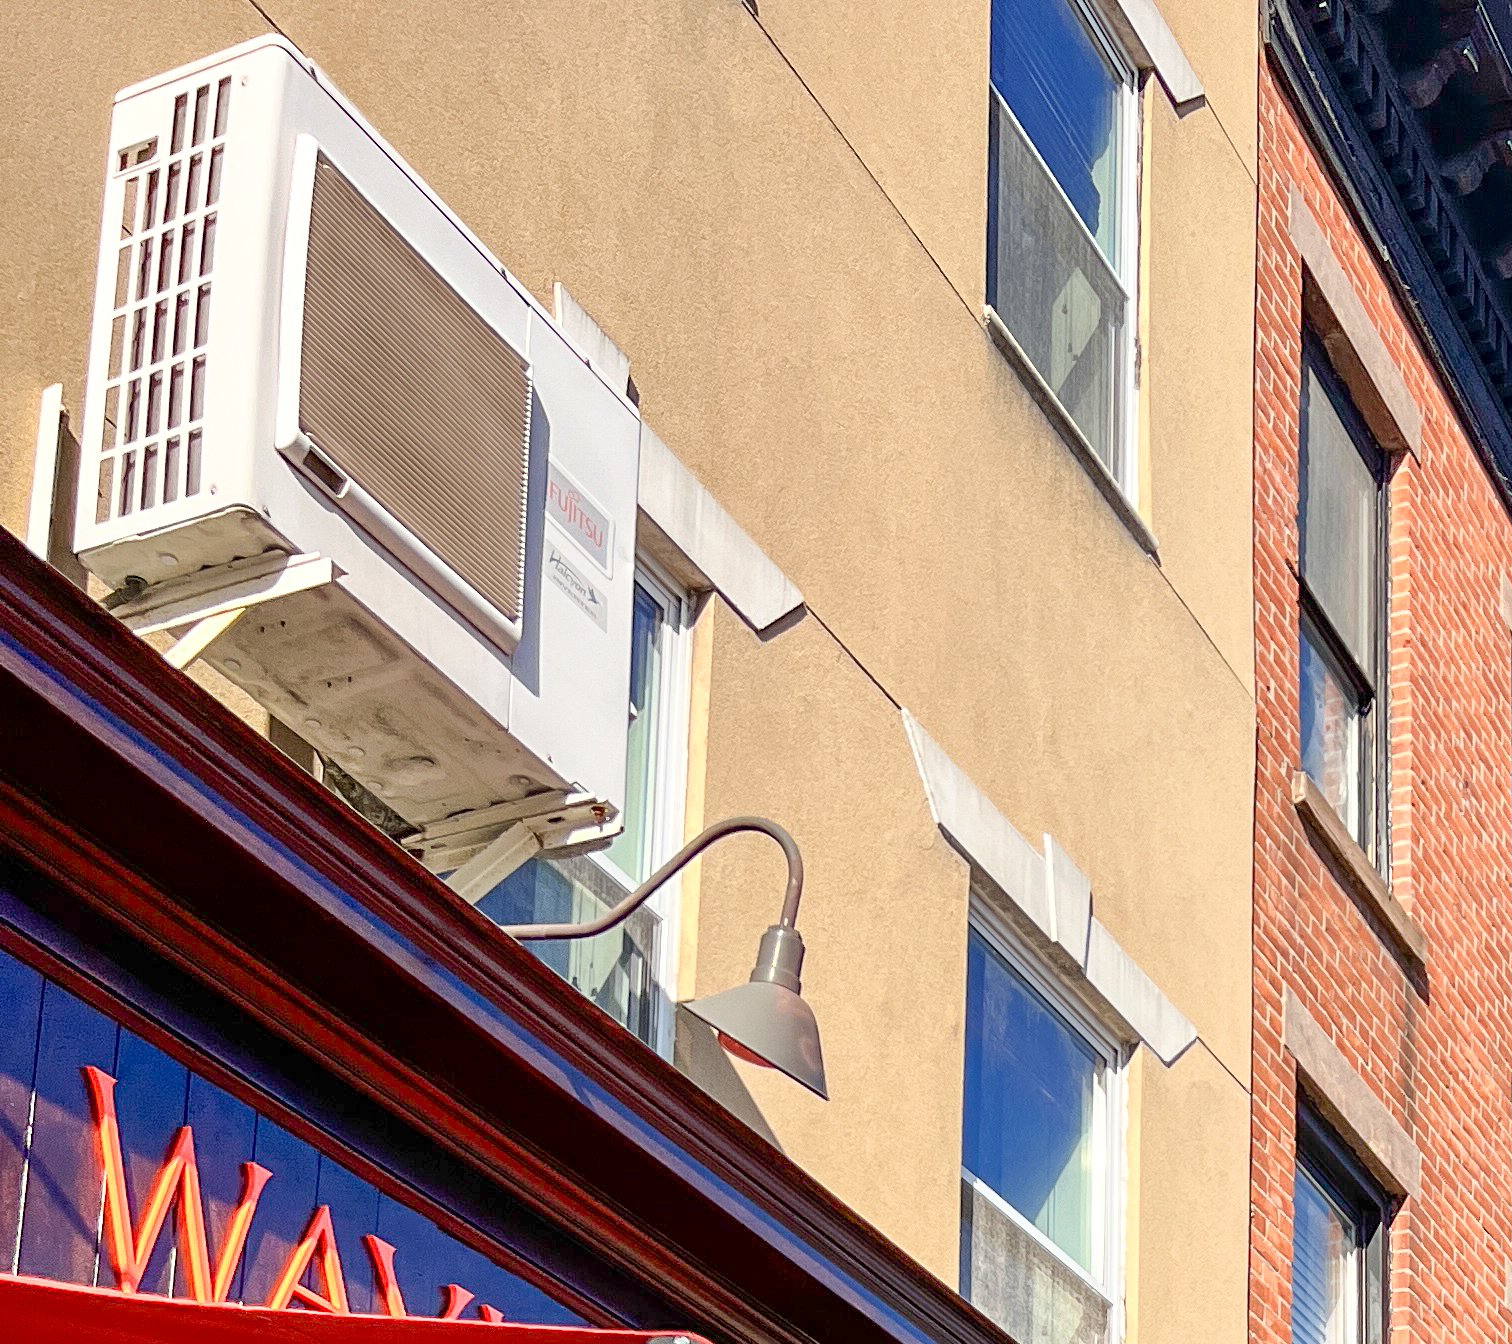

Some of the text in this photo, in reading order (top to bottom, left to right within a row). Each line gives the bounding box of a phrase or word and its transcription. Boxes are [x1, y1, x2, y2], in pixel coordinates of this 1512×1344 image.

[549, 479, 604, 548] FUJITSU
[549, 549, 587, 596] Halcyon
[80, 1064, 505, 1324] WA
